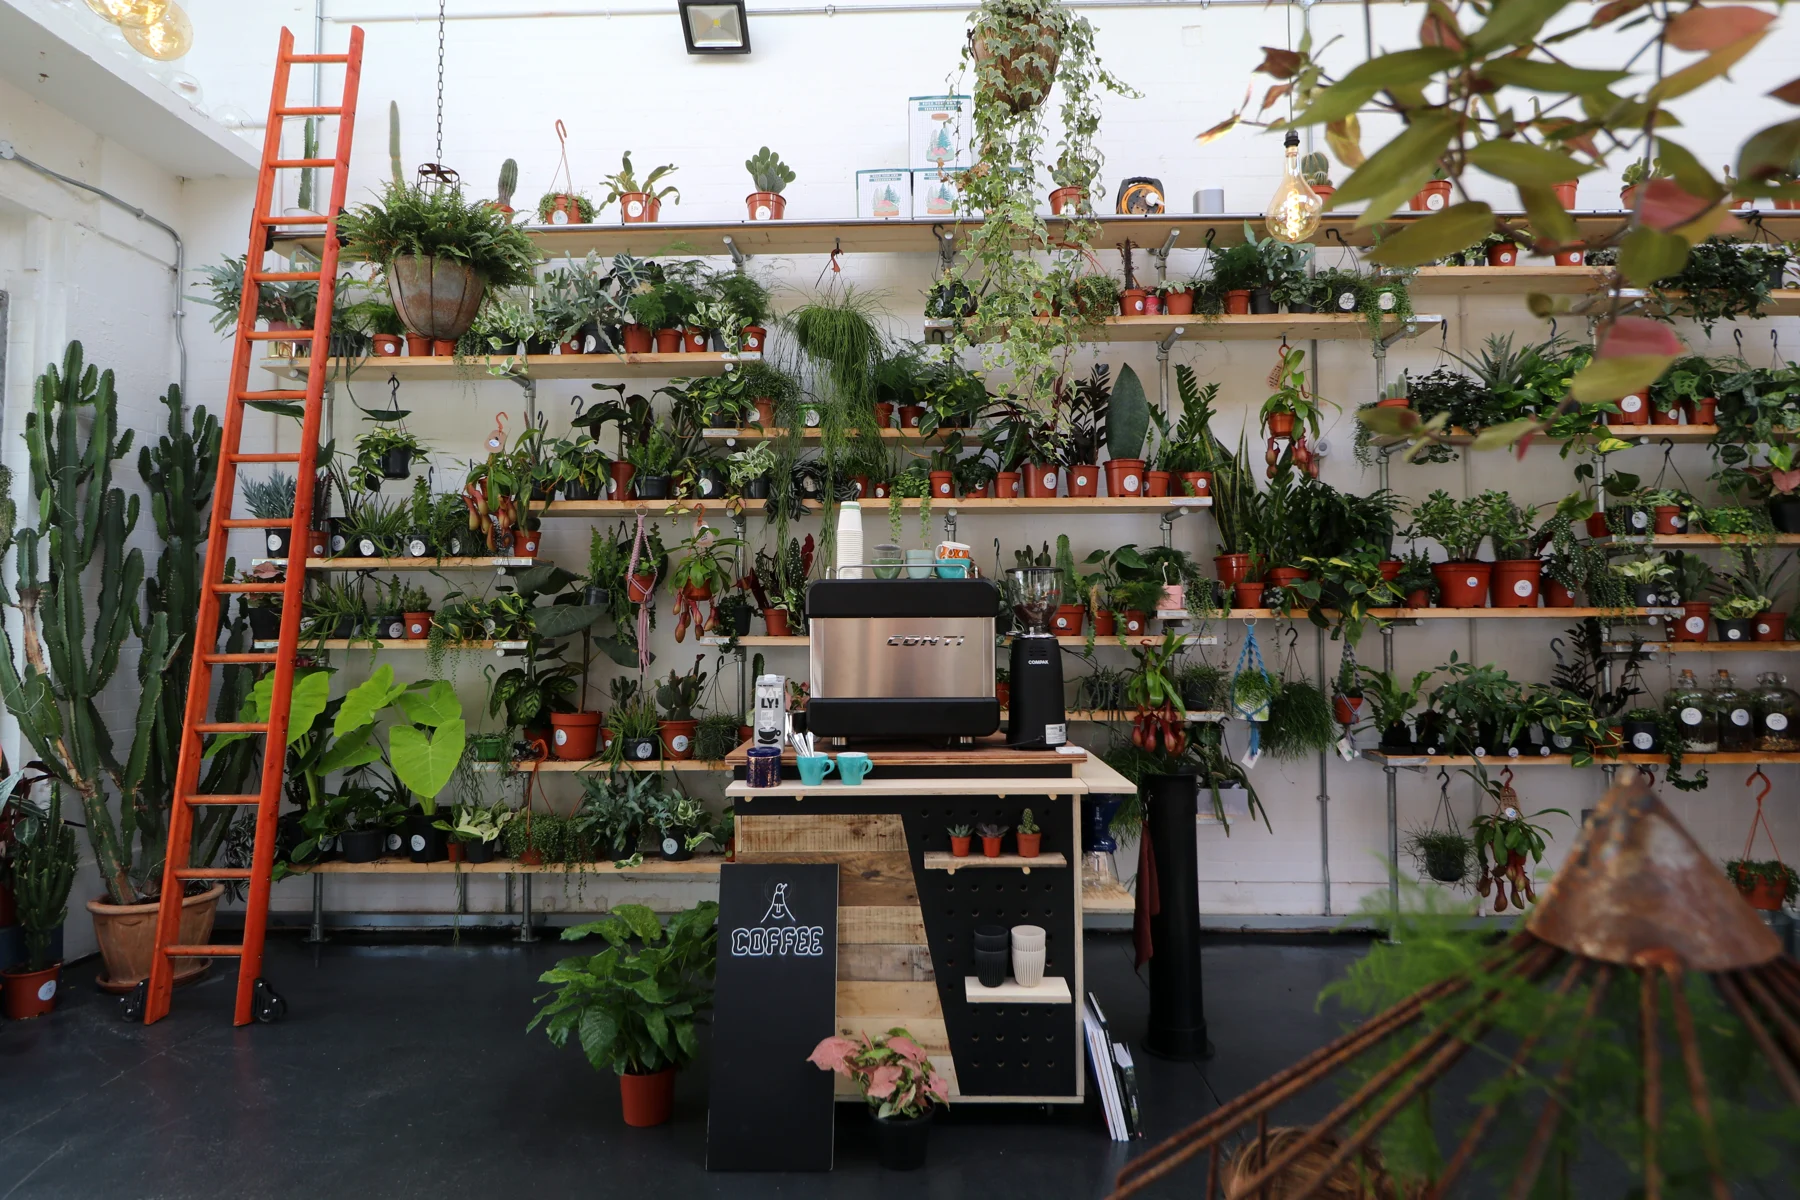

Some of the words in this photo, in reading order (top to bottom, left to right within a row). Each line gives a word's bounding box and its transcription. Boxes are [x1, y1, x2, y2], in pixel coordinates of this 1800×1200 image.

[886, 635, 965, 647] CONTI
[761, 698, 779, 709] LY!
[731, 926, 824, 956] COFFEE
